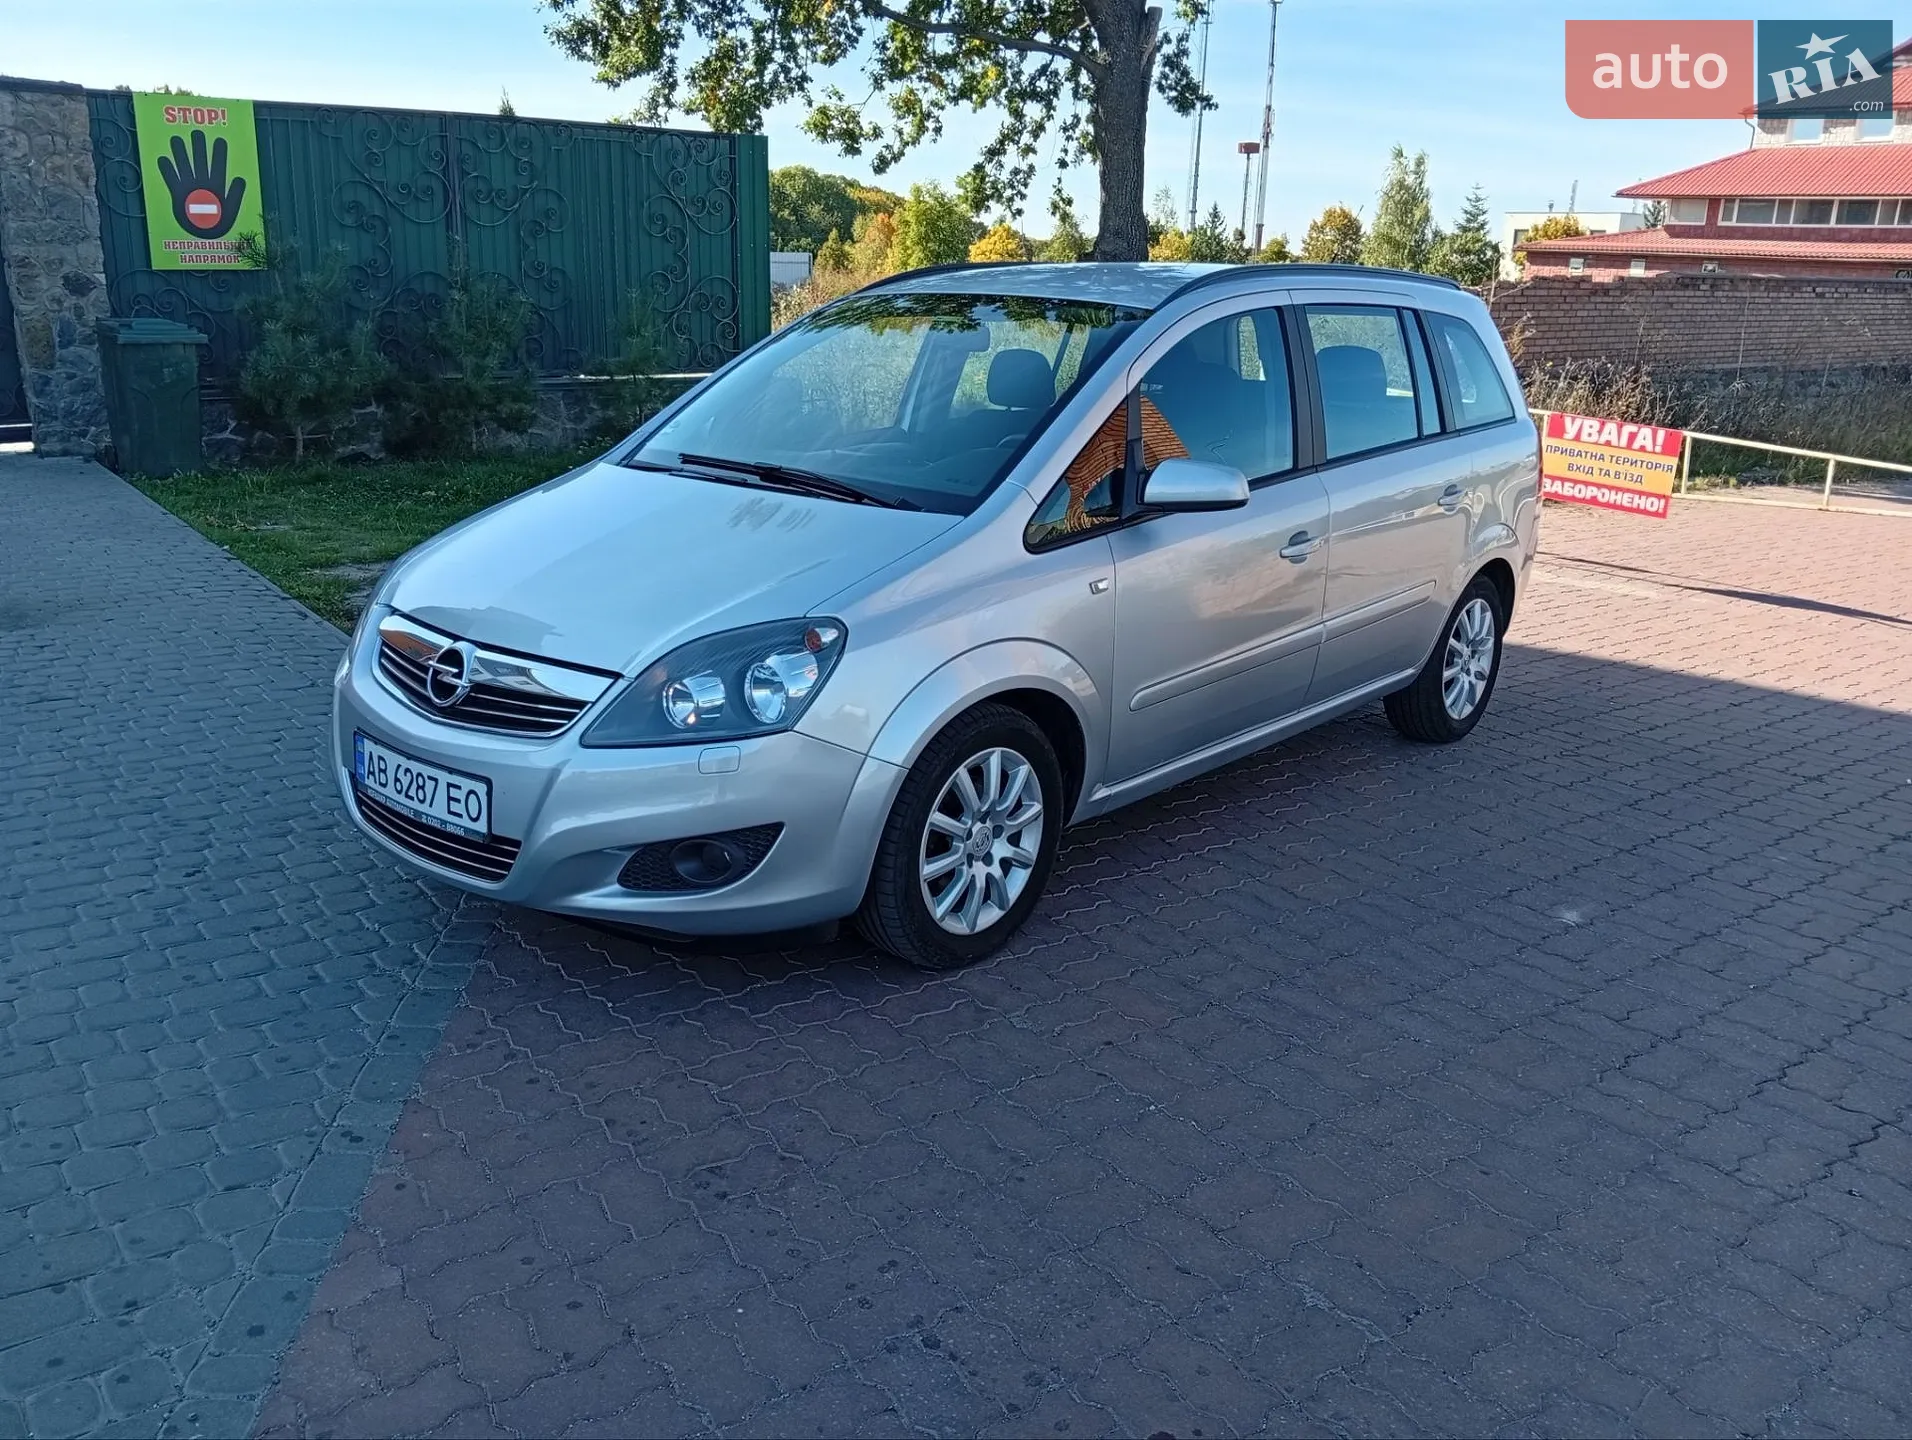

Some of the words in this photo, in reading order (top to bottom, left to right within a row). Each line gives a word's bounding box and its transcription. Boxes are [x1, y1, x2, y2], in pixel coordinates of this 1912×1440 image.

[164, 105, 228, 126] STOP!
[180, 253, 241, 264] НАПРЯМОК
[1563, 416, 1666, 454] УВАГА!
[1545, 444, 1605, 463] ПРИВАТНА
[1609, 454, 1674, 473] ТЕРИТОРІЯ
[1567, 463, 1594, 477] ВХІД
[1598, 468, 1611, 478] ТА
[1543, 478, 1666, 513] ЗАБОРОНЕНО!
[366, 751, 389, 789] AB
[394, 763, 439, 808] 6287
[446, 781, 483, 823] EO
